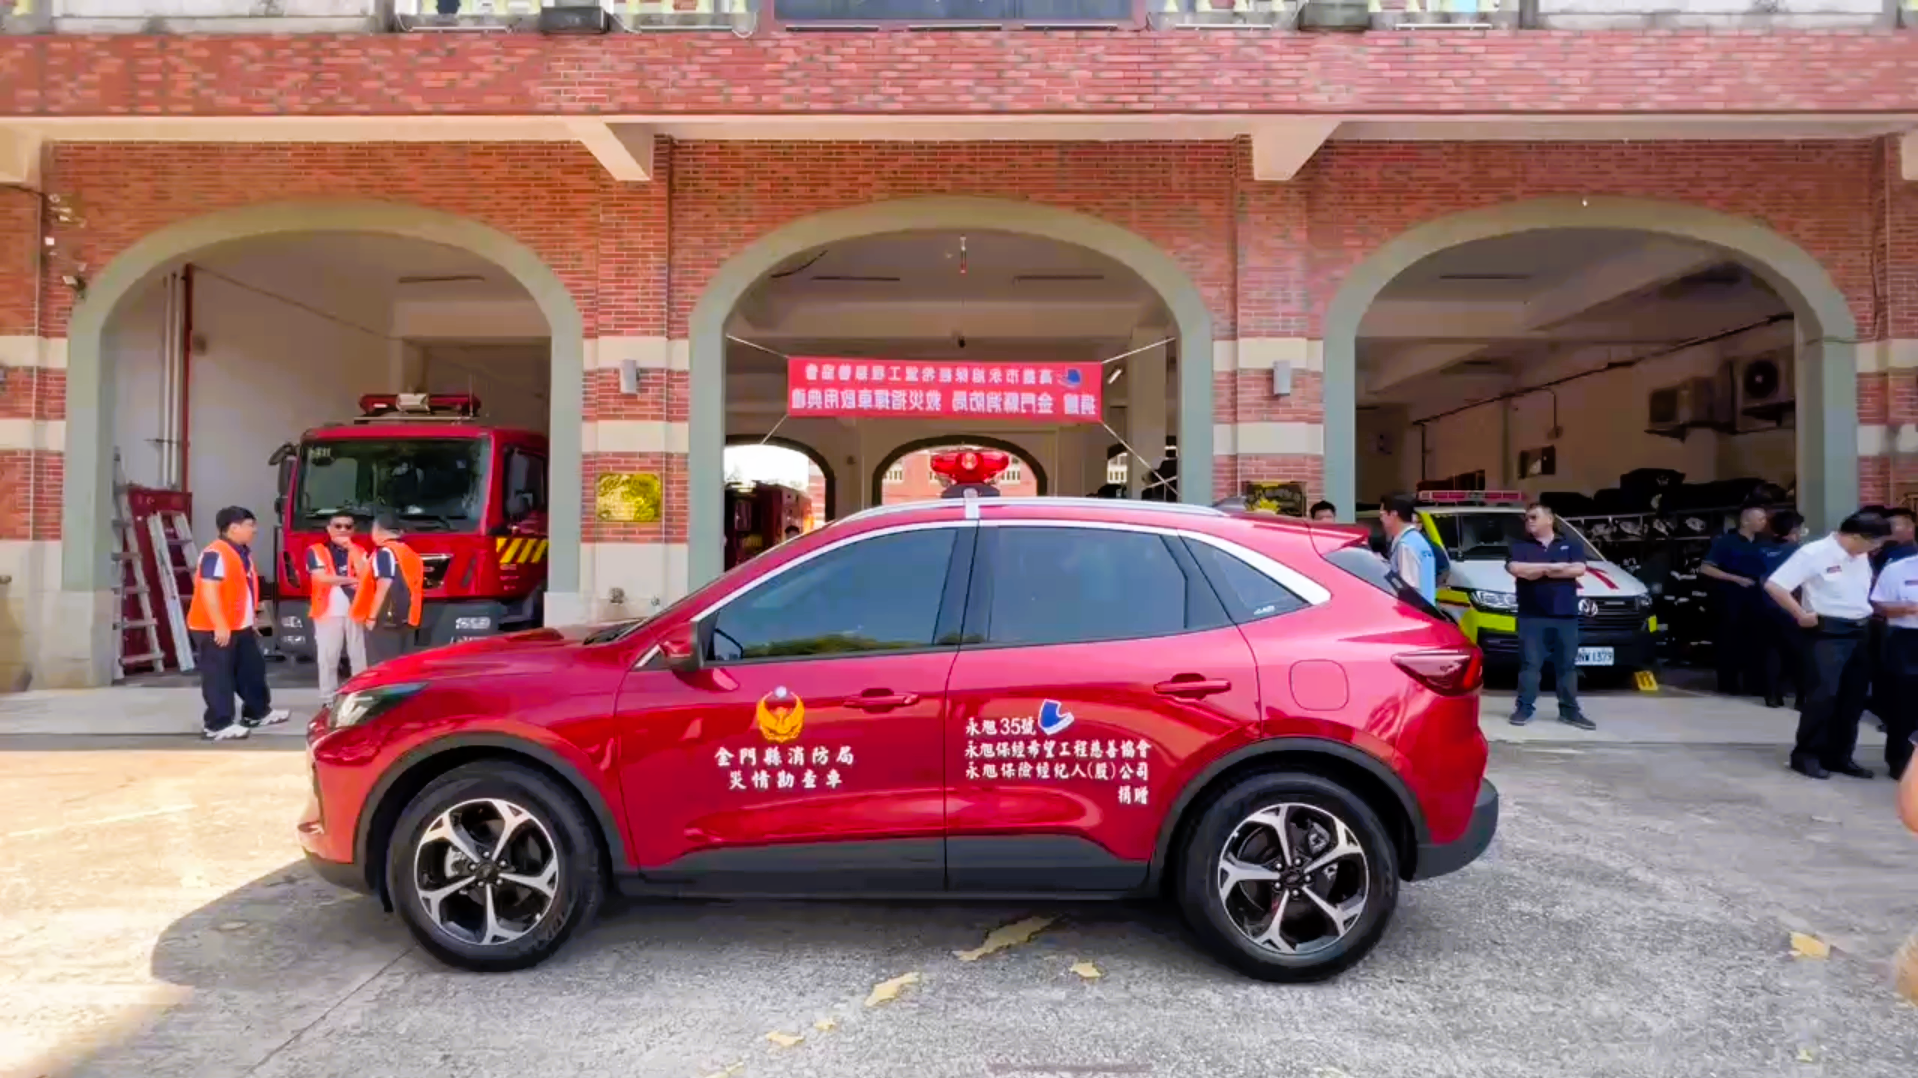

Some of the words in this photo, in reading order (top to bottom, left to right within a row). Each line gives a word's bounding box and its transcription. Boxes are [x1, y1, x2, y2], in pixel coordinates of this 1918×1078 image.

[714, 746, 855, 767] 金門縣消防局
[964, 739, 1151, 758] 永旭保經希望工程慈善協會
[729, 769, 843, 790] 災情勘查車
[1117, 785, 1149, 805] 捐贈
